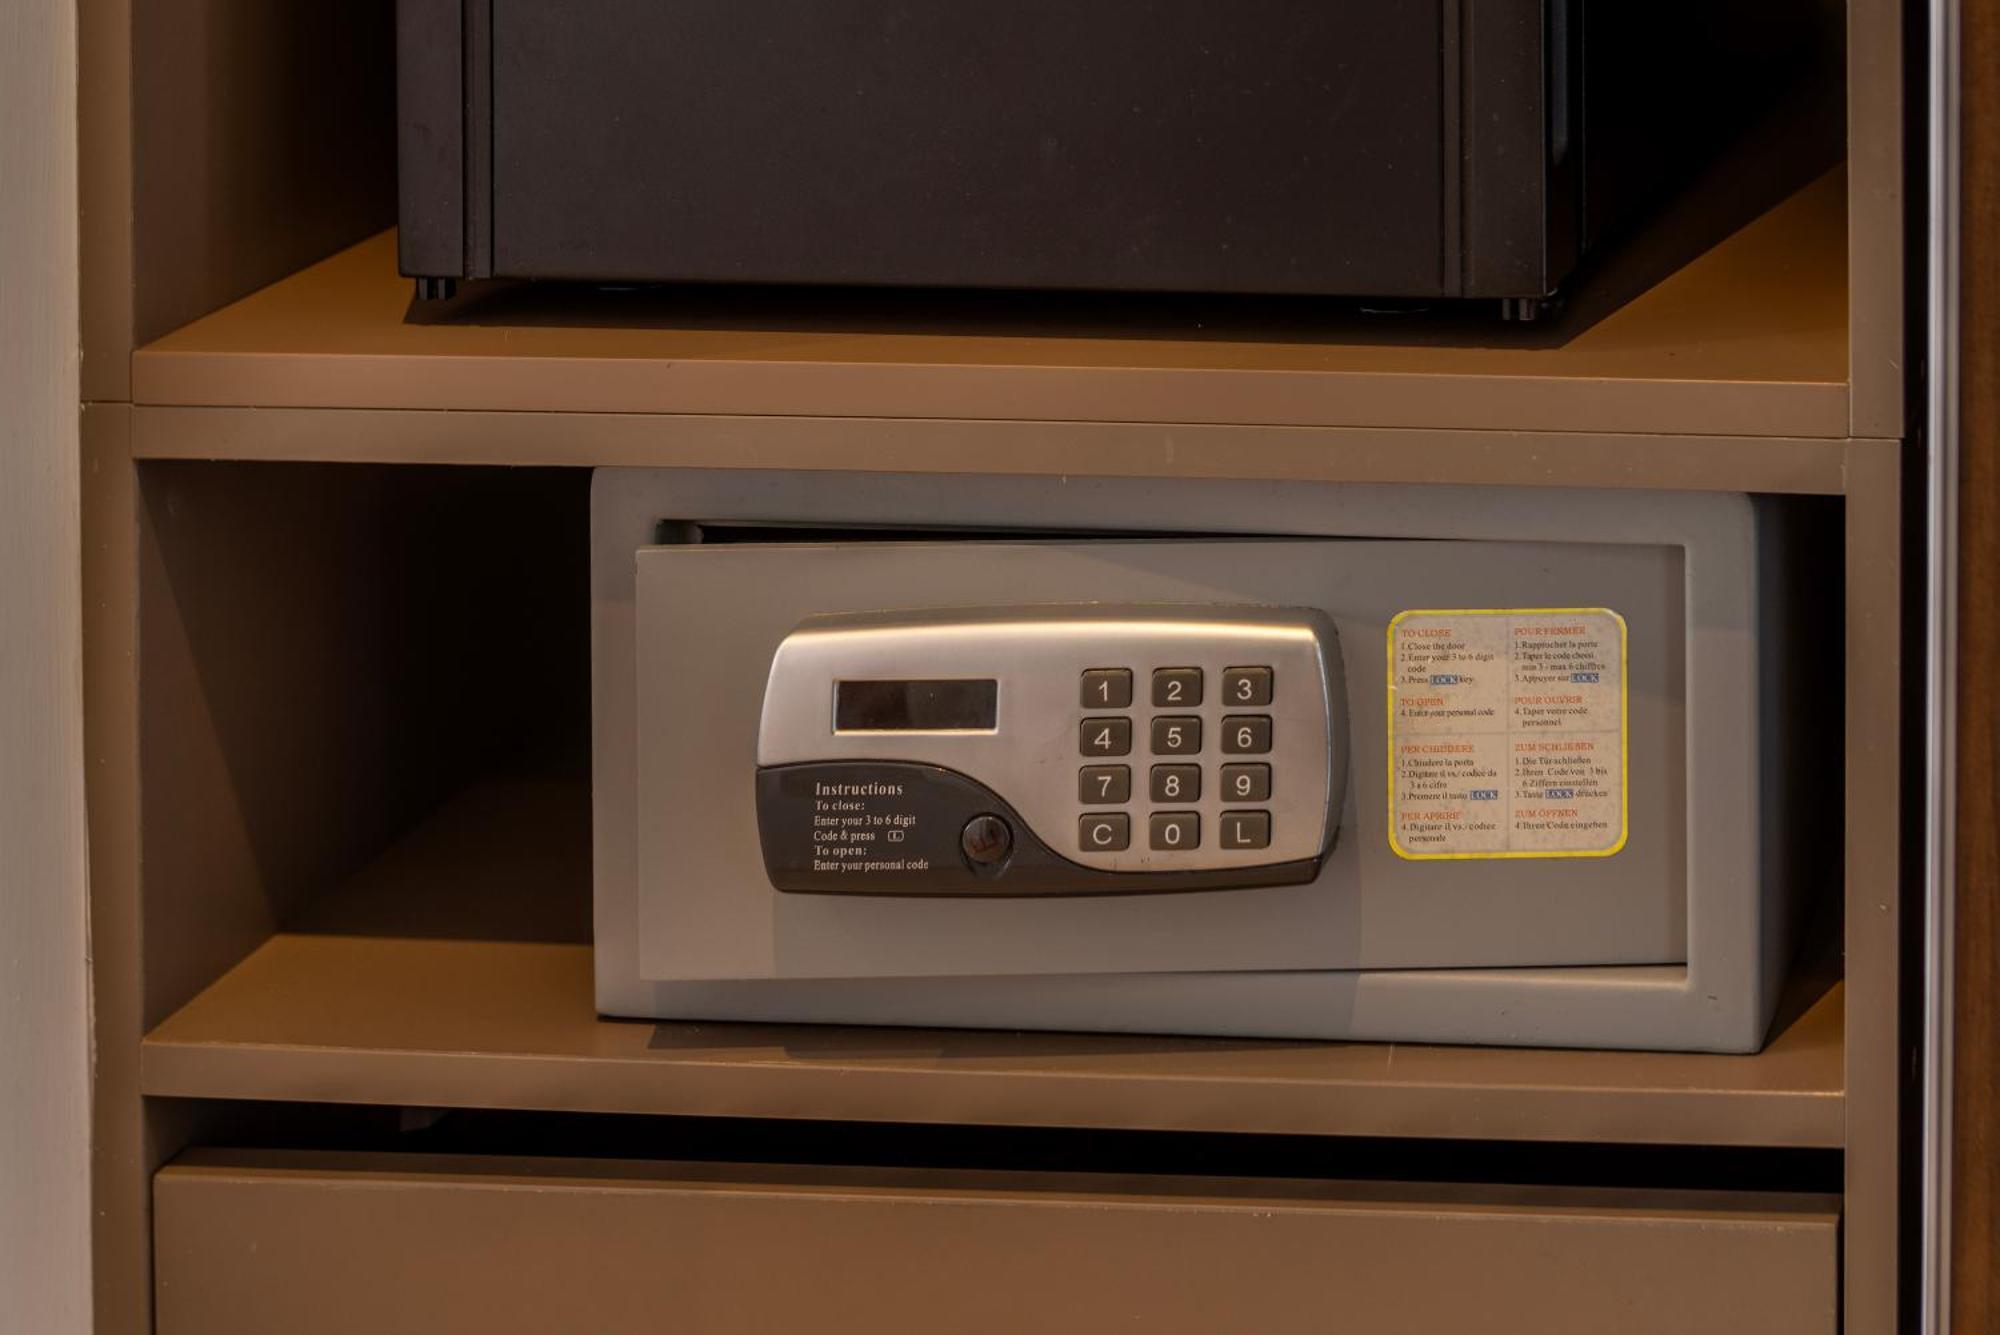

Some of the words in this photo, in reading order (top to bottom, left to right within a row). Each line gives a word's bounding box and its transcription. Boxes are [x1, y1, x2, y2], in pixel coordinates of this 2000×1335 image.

[1403, 629, 1416, 637] TO
[1418, 629, 1452, 637] CLOSE
[1514, 628, 1543, 636] POUR
[1432, 642, 1445, 650] the
[1447, 642, 1465, 650] door
[1431, 655, 1450, 663] your
[1475, 653, 1494, 662] digit
[1408, 665, 1426, 673] code
[1460, 676, 1473, 684] key
[1098, 681, 1109, 702] 1
[1167, 681, 1182, 701] 2
[1236, 679, 1252, 700] 3
[1402, 698, 1414, 706] TO
[1514, 696, 1542, 704] POUR
[1478, 708, 1494, 716] code
[1094, 728, 1112, 750] 4
[1167, 727, 1182, 748] 5
[1237, 727, 1252, 747] 6
[1488, 769, 1497, 777] da
[1596, 767, 1607, 775] bis
[816, 782, 903, 796] Instructions
[1097, 776, 1112, 797] 7
[1165, 775, 1180, 796] 8
[1236, 775, 1251, 796] 9
[816, 801, 829, 811] To
[832, 801, 865, 811] close:
[814, 815, 839, 826] Enter
[842, 817, 863, 828] your
[865, 815, 871, 825] 3
[873, 815, 883, 825] to
[885, 815, 891, 825] 6
[893, 814, 916, 827] digit
[814, 831, 838, 841] Code
[840, 832, 848, 840] &
[850, 833, 876, 843] press
[1093, 824, 1113, 845] C
[1165, 824, 1180, 845] 0
[1236, 822, 1251, 843] L
[815, 846, 829, 856] To
[832, 847, 867, 858] open:
[814, 860, 839, 871] Enter
[842, 862, 862, 872] your
[864, 860, 905, 872] personal
[906, 859, 929, 869] code
